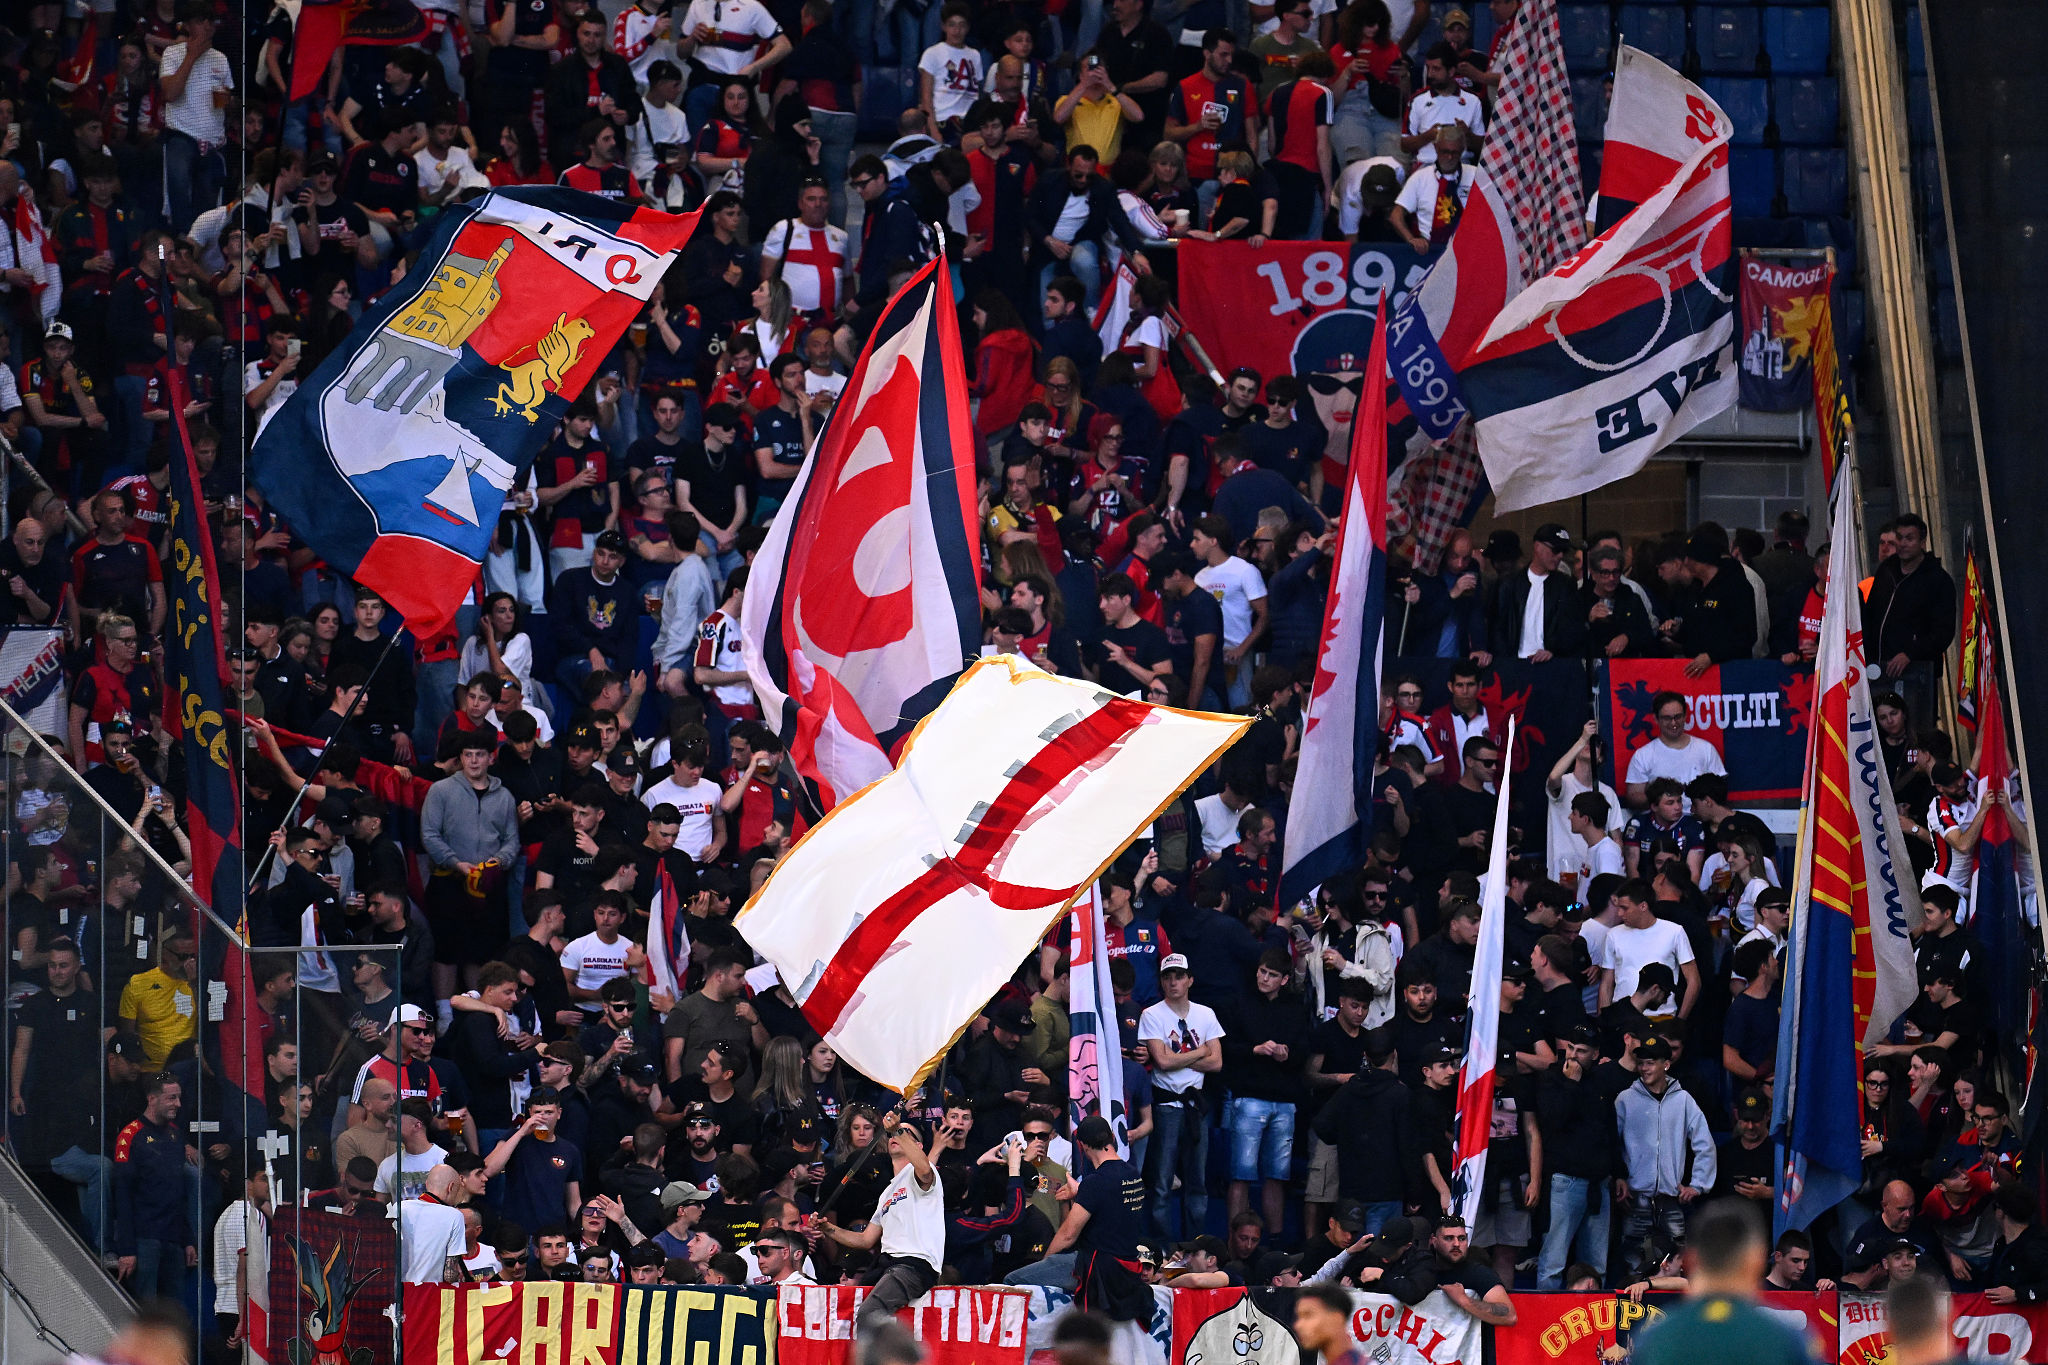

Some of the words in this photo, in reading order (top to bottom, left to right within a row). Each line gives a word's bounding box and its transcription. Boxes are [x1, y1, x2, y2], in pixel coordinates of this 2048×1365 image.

[1401, 343, 1466, 427] 1893
[1683, 690, 1781, 732] CCULTI
[780, 1285, 1027, 1348] COLTTIVO
